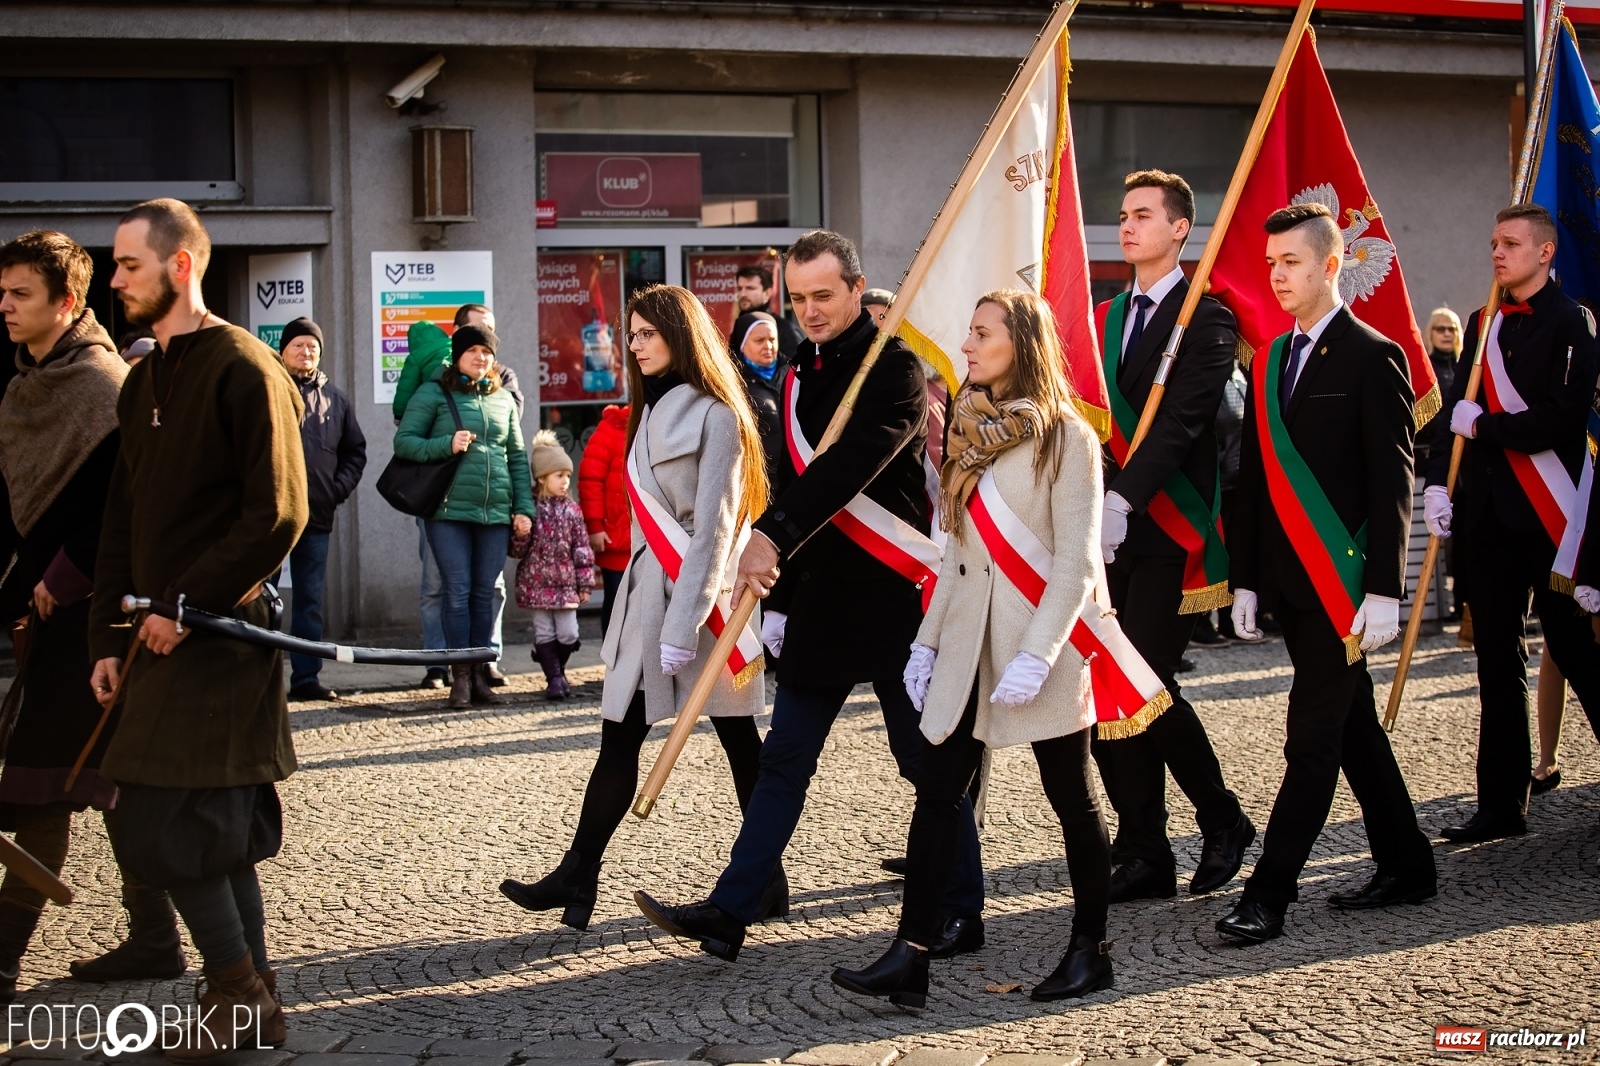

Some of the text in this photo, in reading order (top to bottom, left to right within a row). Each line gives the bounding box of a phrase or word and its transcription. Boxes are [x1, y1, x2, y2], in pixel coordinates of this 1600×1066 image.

[603, 178, 639, 190] KLUB
[581, 209, 669, 218] www.rossmann.pl/klub
[408, 263, 435, 275] TEB
[537, 261, 577, 277] ysiące
[278, 280, 304, 295] TEB
[537, 275, 580, 291] owych
[278, 297, 304, 305] EDUKACJA
[537, 290, 590, 305] romocji!
